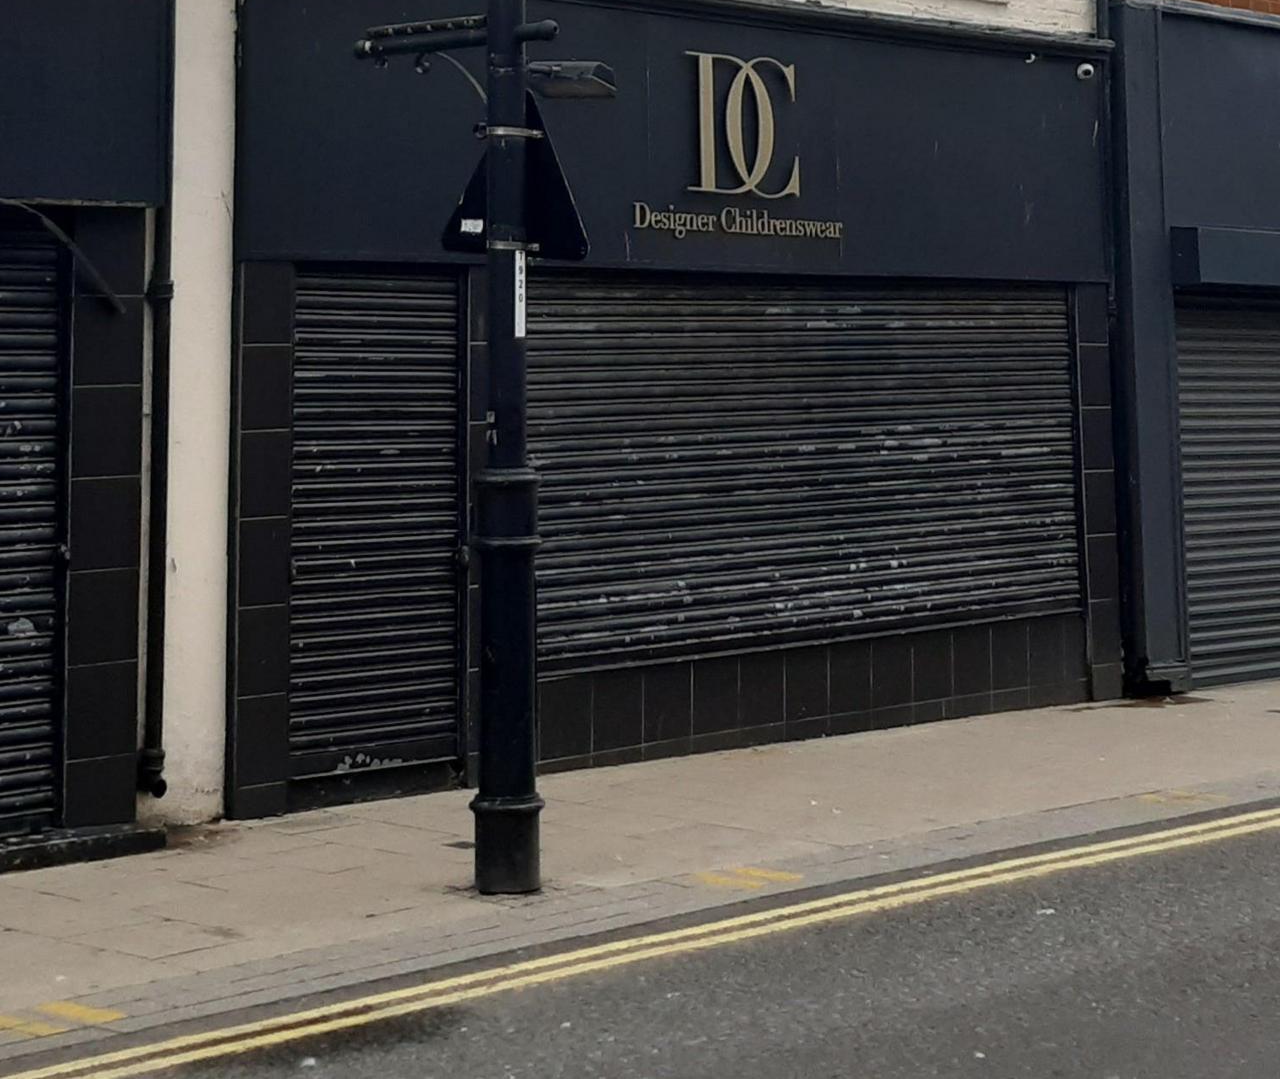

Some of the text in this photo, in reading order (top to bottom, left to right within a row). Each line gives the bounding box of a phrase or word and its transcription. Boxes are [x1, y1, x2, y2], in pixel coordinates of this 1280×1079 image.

[685, 50, 800, 199] DC
[633, 201, 843, 239] Designer Childrenswear
